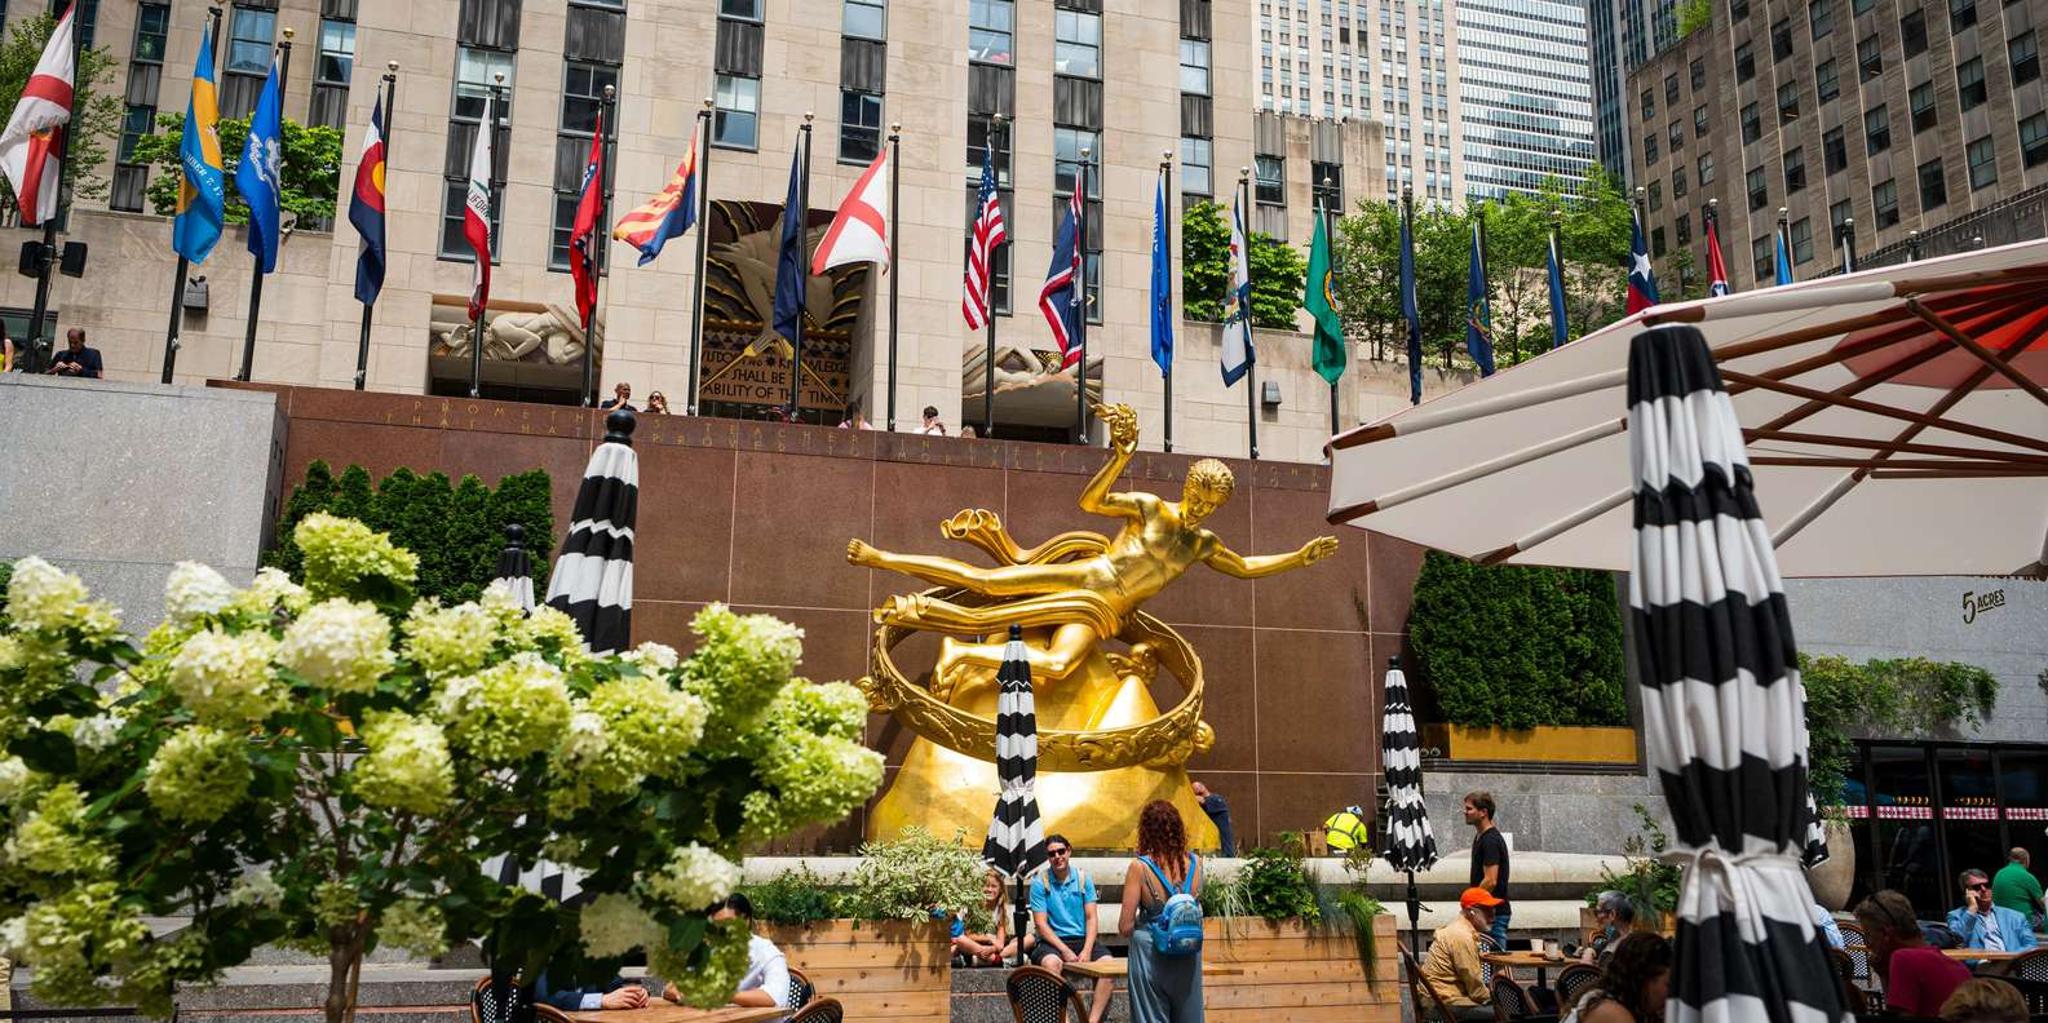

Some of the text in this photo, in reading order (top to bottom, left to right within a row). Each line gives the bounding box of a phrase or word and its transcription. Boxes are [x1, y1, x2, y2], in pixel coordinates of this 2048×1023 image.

[732, 368, 769, 383] SHALL
[771, 371, 786, 384] BE
[755, 386, 775, 399] OF
[1962, 589, 2006, 624] 5 ACRES
